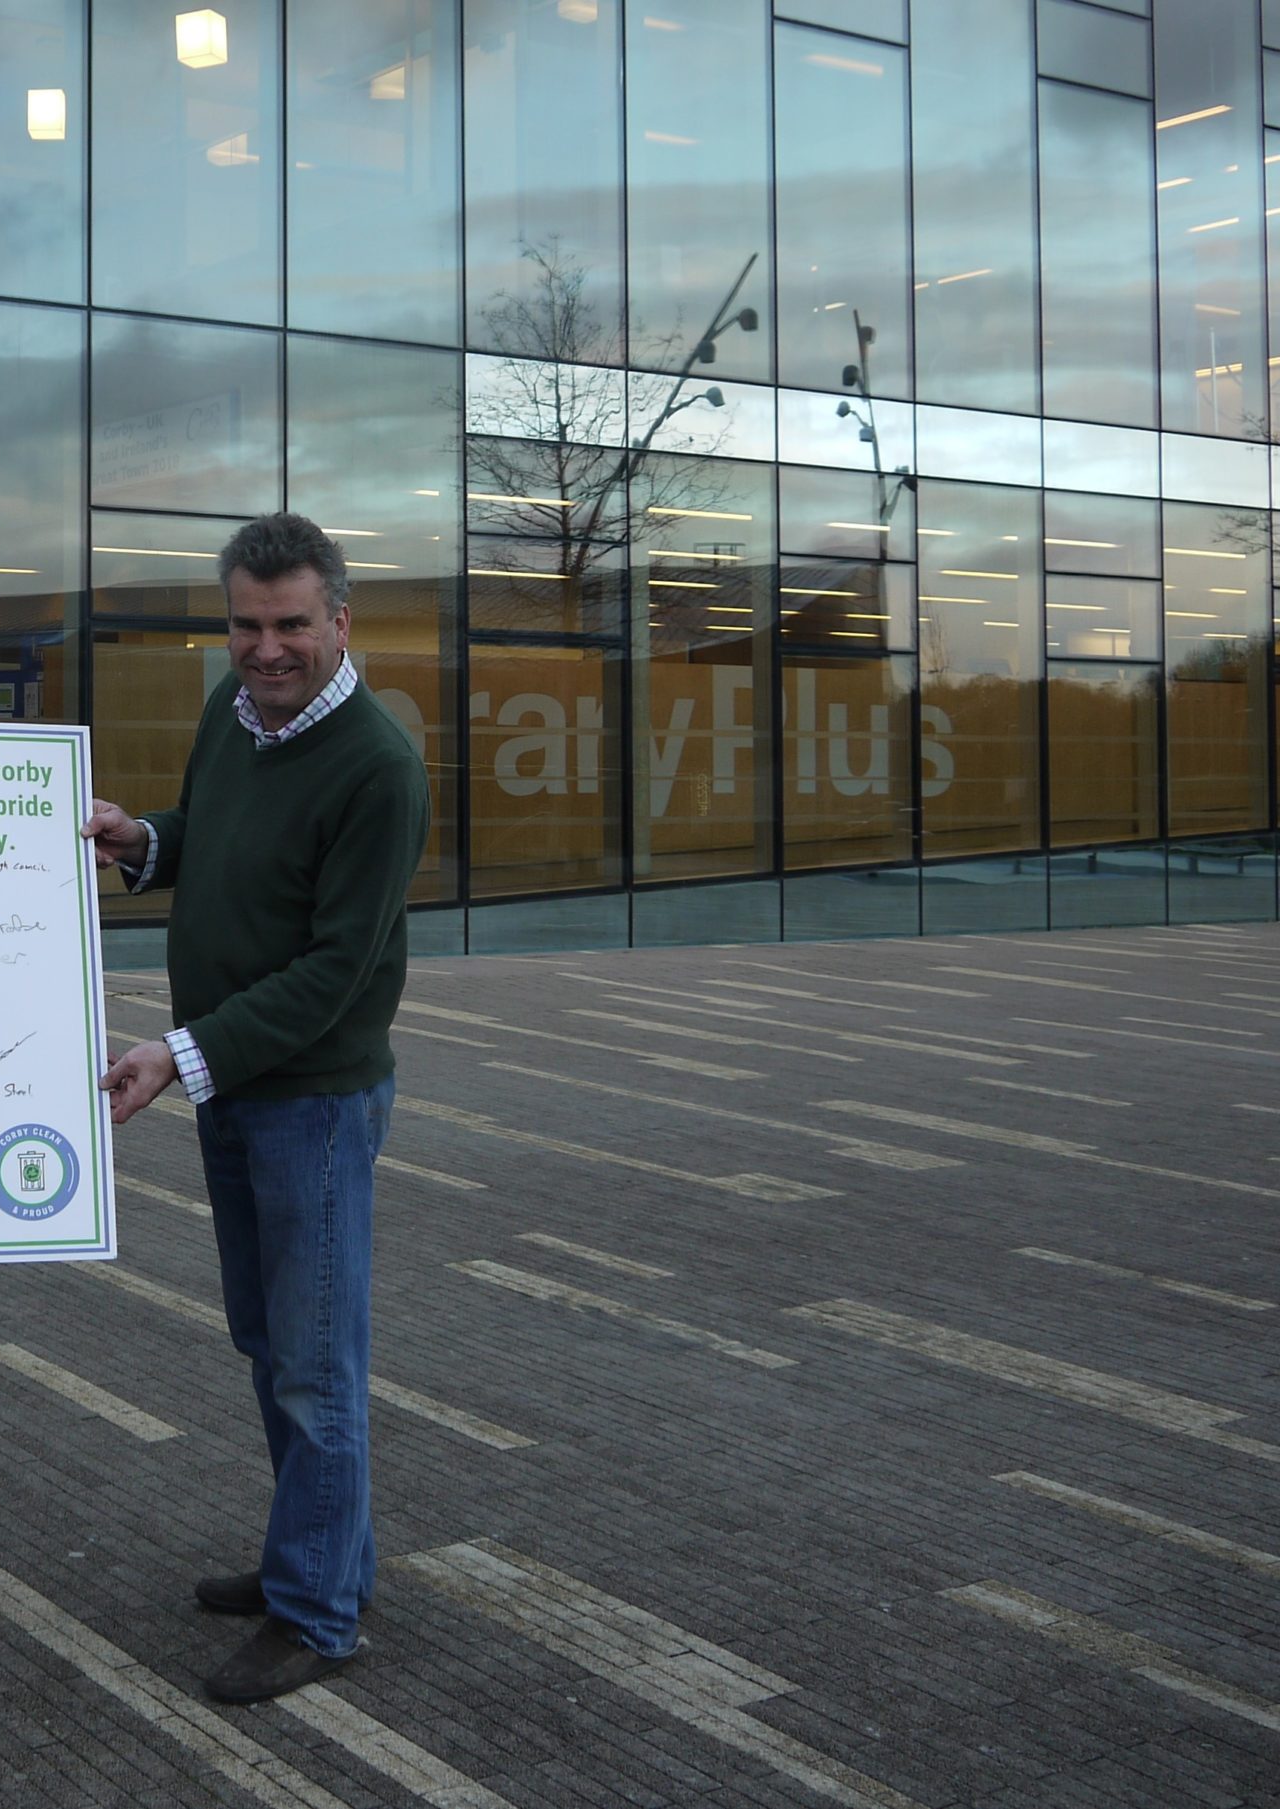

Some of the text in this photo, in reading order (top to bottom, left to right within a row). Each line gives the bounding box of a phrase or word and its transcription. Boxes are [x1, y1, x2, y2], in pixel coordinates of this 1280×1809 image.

[0, 1127, 63, 1147] CORBY CLEAN
[22, 1204, 55, 1217] PROUD
